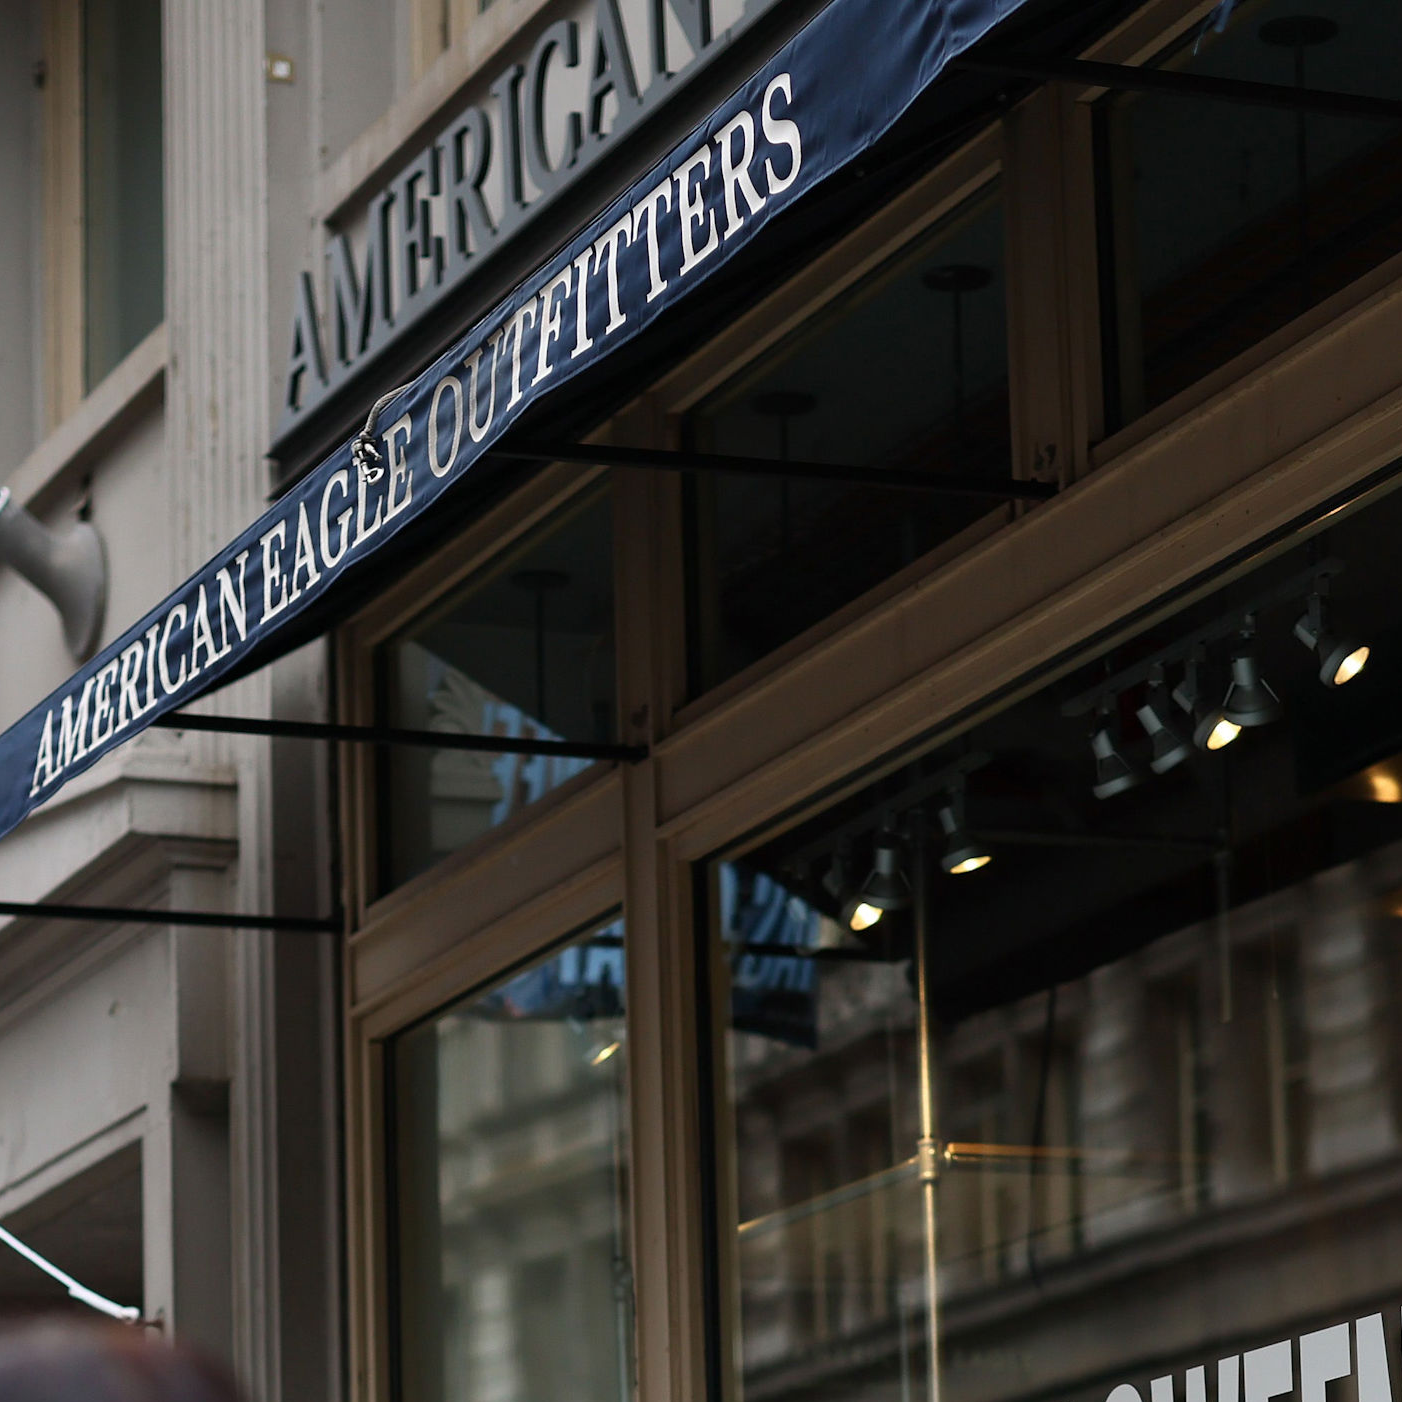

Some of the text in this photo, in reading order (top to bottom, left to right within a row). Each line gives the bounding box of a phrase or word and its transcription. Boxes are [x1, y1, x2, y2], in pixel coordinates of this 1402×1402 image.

[29, 550, 249, 799] AMERICAN
[260, 422, 413, 626] EAGLE
[427, 72, 802, 478] OUTFITTERS
